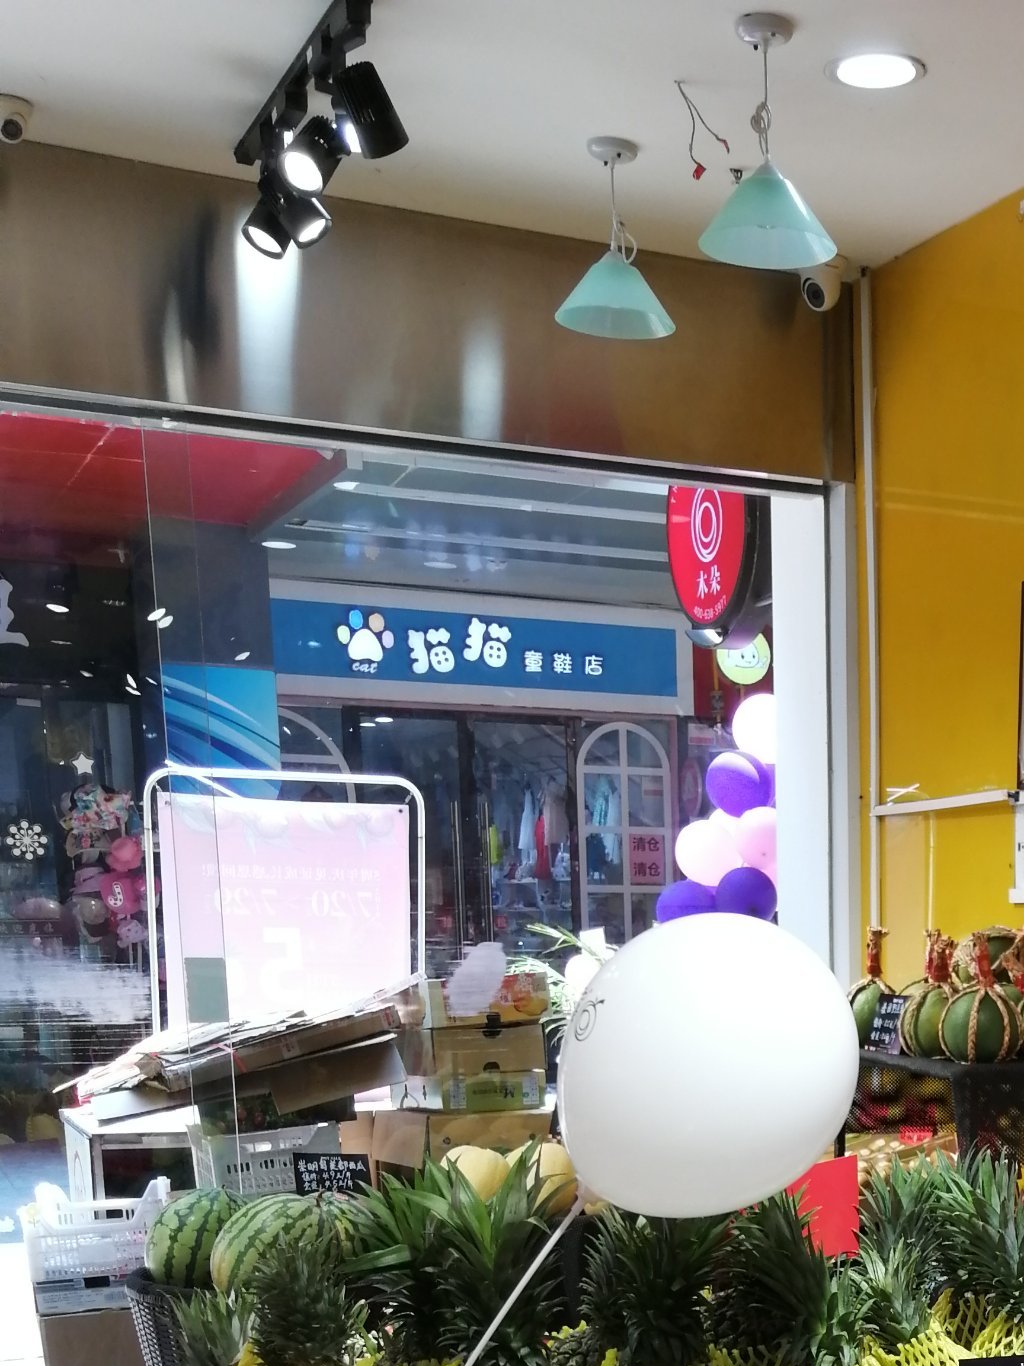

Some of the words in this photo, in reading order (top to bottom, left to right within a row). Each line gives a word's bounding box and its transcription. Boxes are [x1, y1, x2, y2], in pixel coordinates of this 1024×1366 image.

[696, 565, 720, 599] 木朵
[352, 661, 377, 674] cat
[524, 650, 604, 676] 童鞋店
[632, 837, 660, 852] 清仓
[633, 862, 661, 877] 清仓
